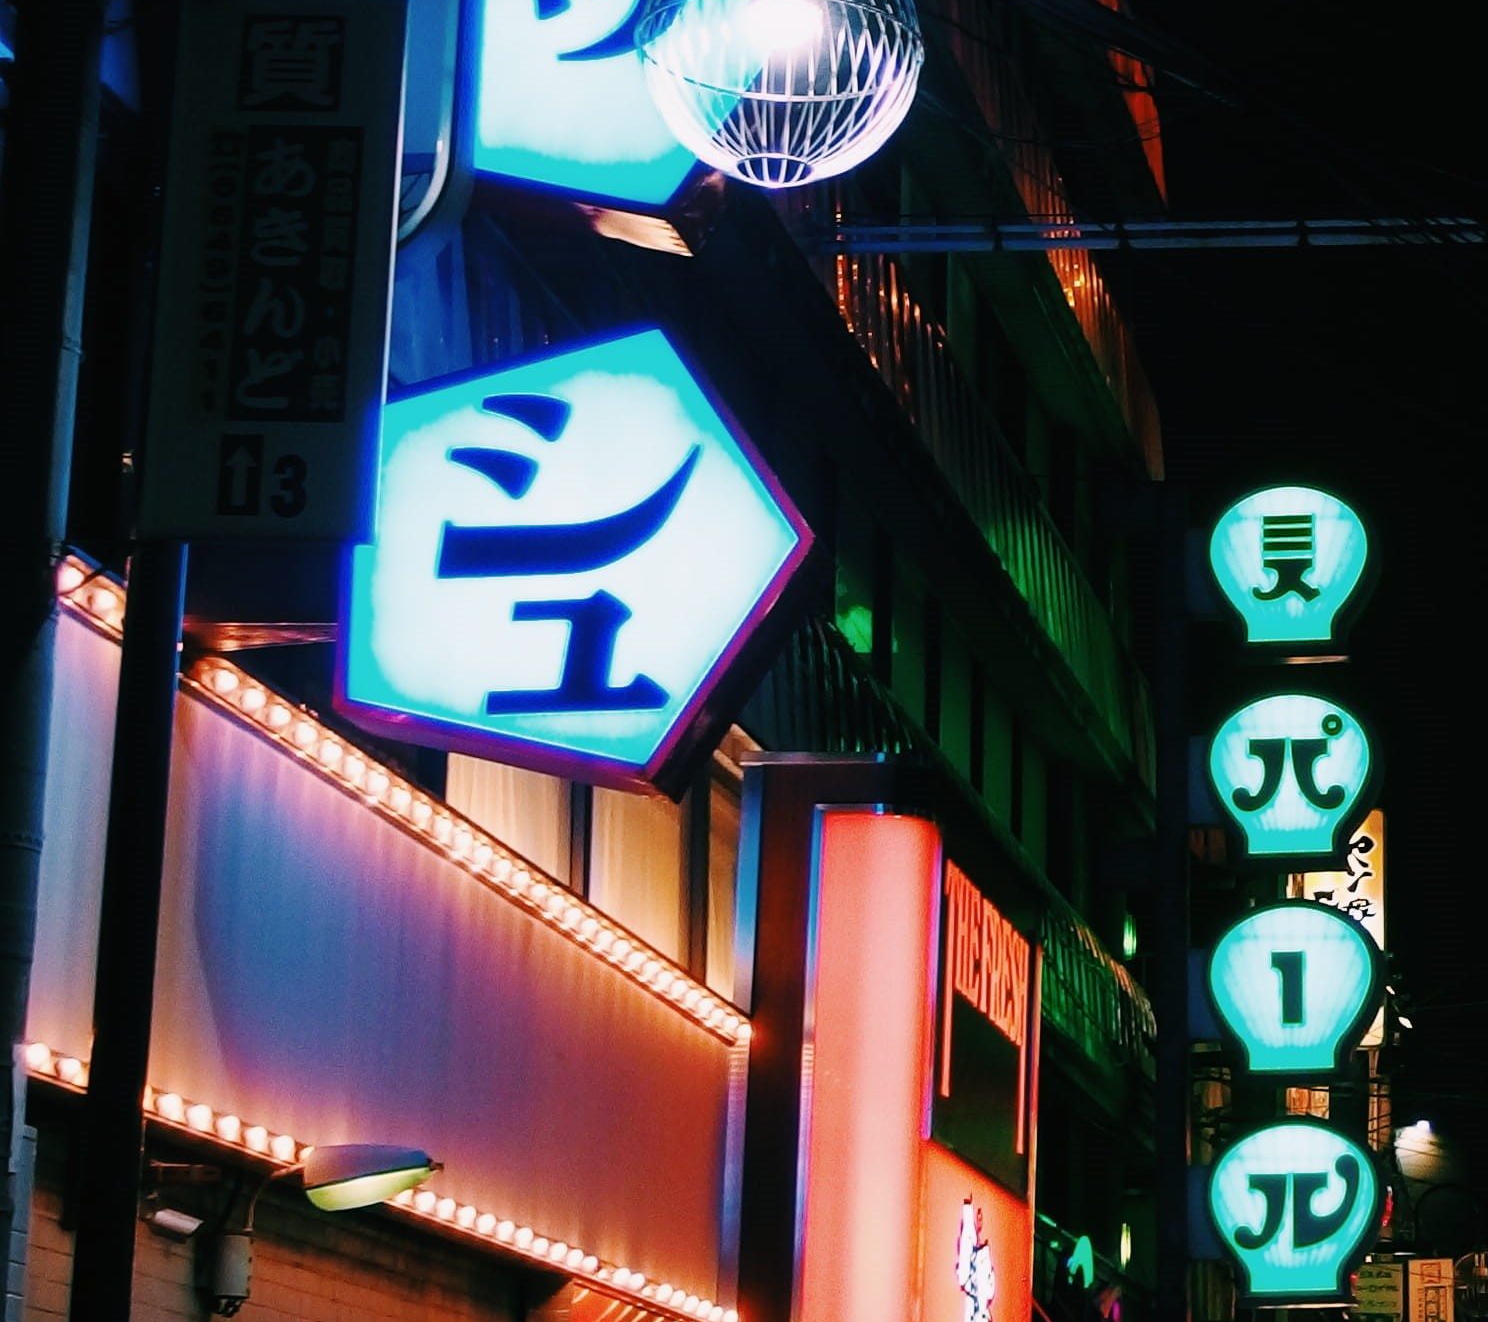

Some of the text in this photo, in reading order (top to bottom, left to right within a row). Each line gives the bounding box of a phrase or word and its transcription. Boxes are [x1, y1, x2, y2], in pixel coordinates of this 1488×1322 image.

[235, 137, 319, 411] あきんど
[269, 453, 309, 519] 3
